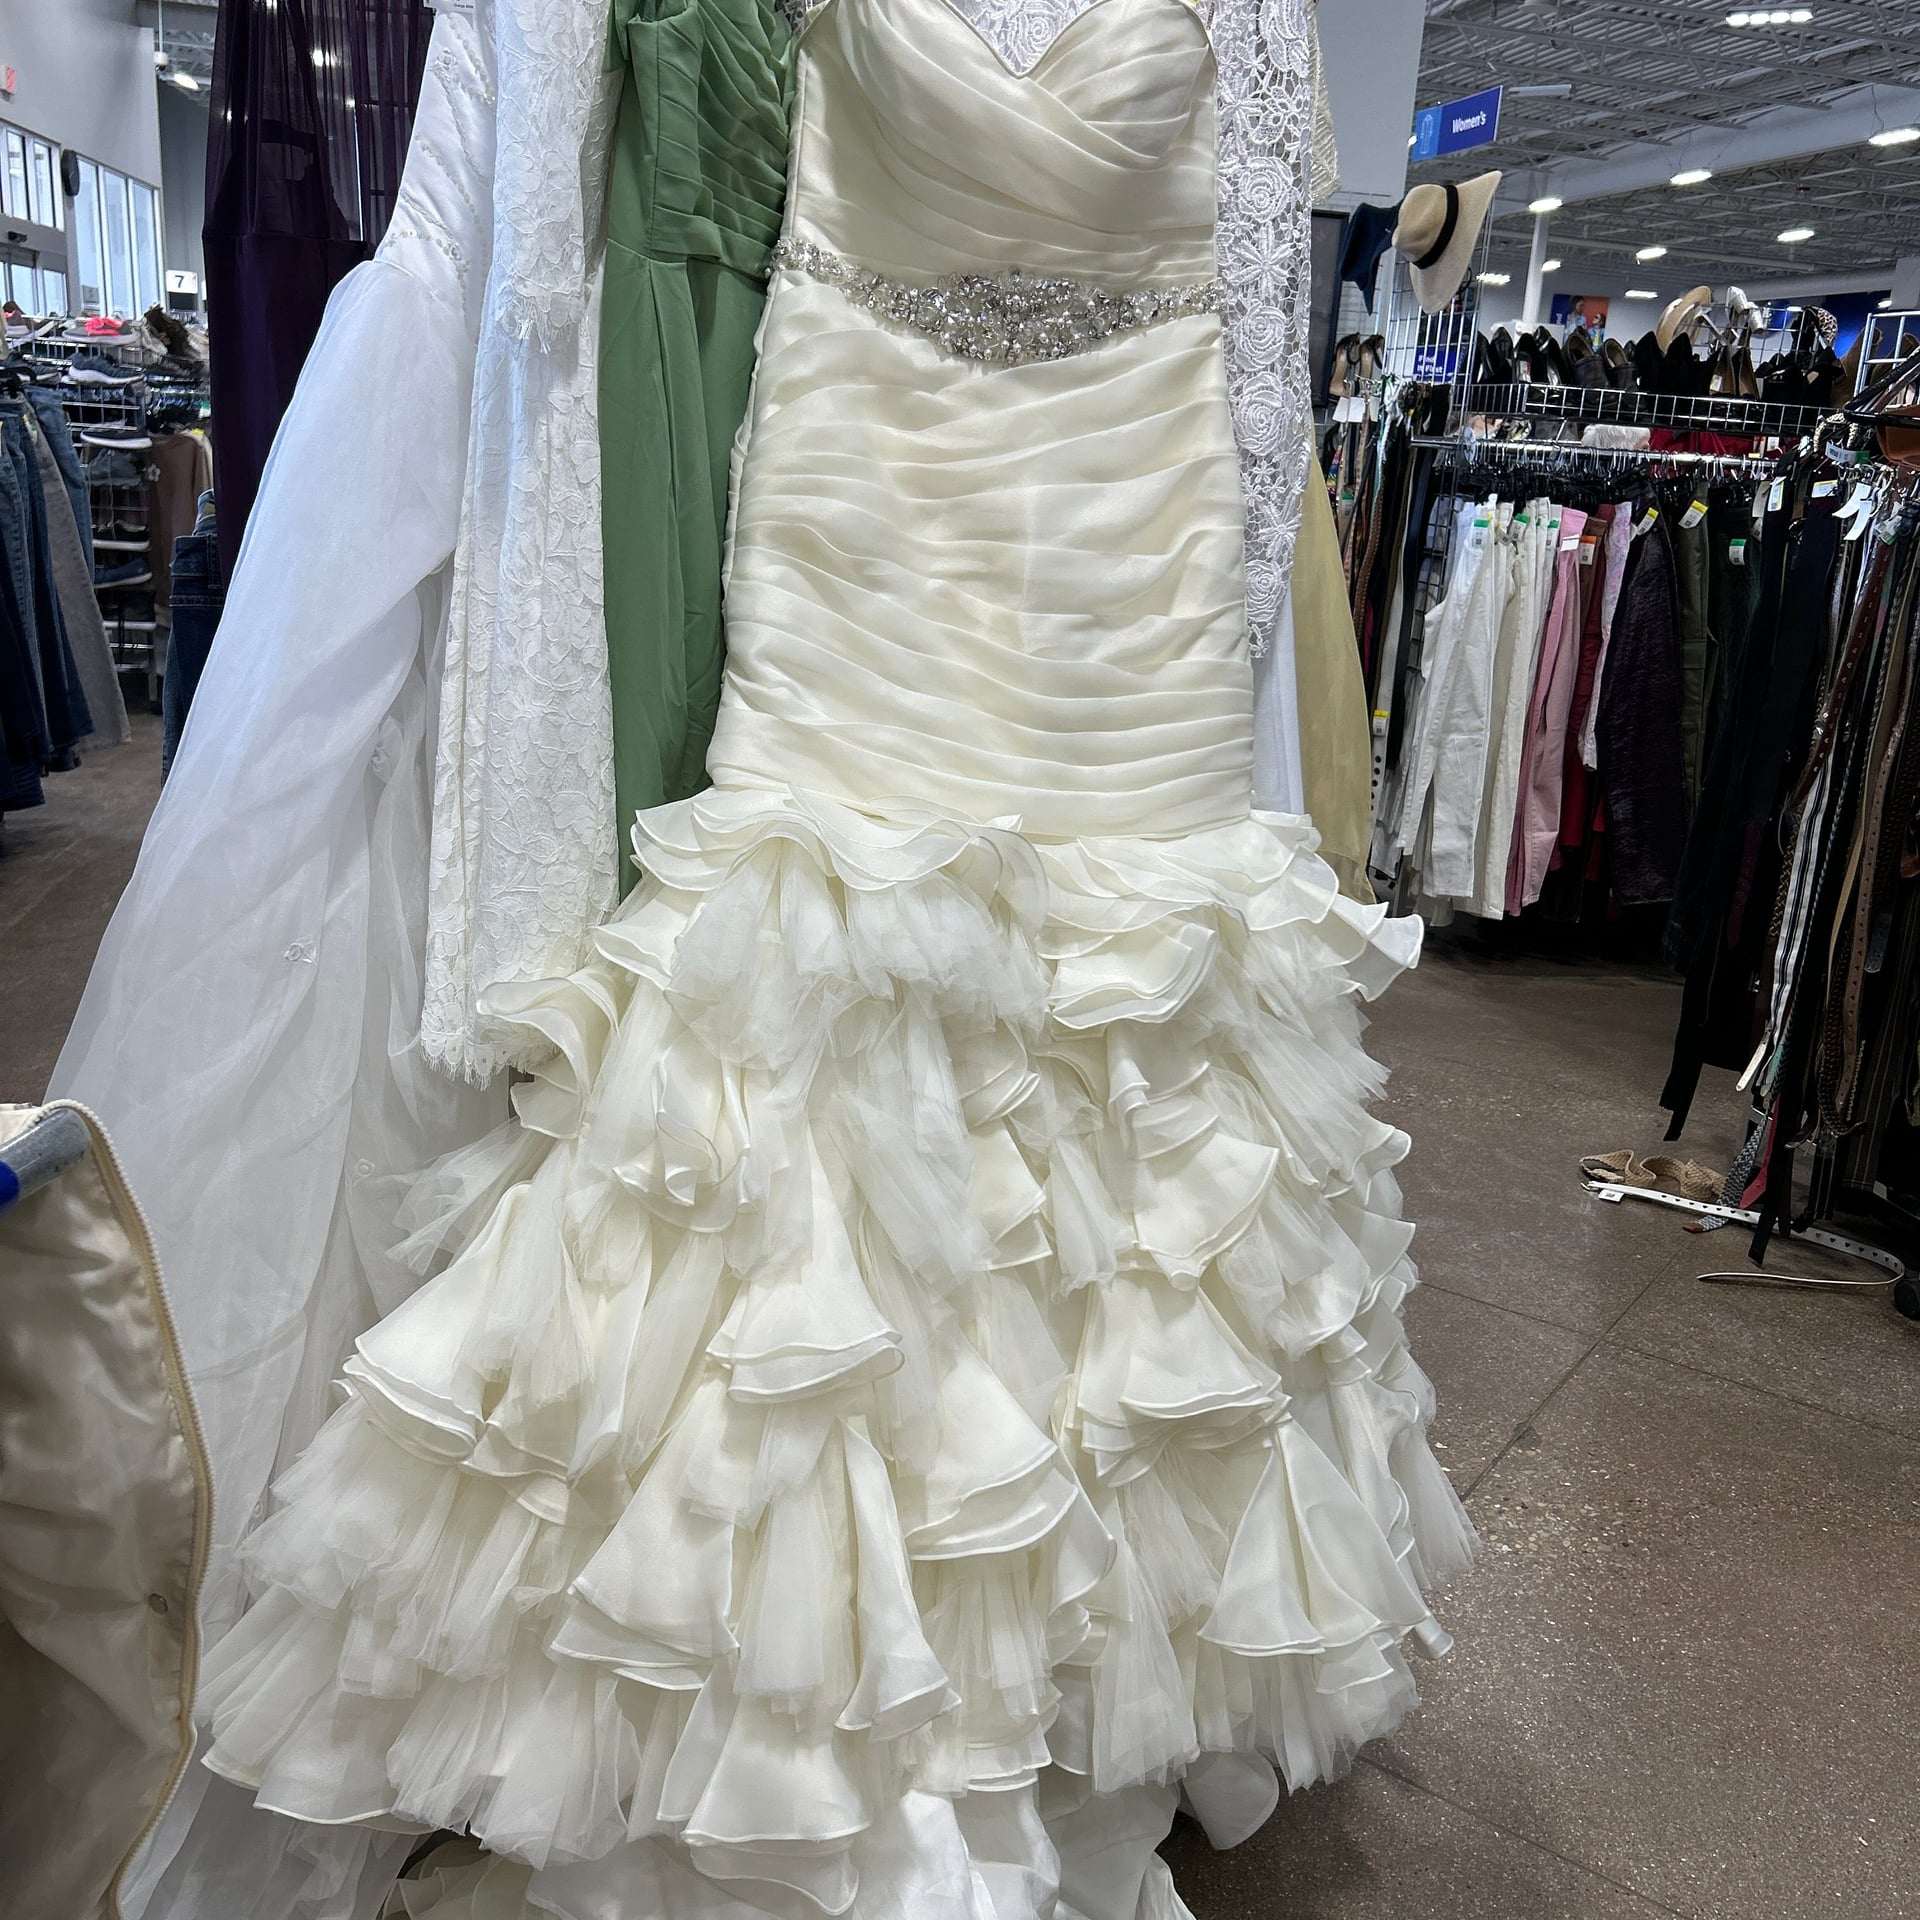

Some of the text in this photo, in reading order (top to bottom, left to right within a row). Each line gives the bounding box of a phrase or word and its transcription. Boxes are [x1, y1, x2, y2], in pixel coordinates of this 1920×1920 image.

[1452, 110, 1486, 134] Women's
[174, 274, 185, 289] 7
[1426, 364, 1443, 373] Fist
